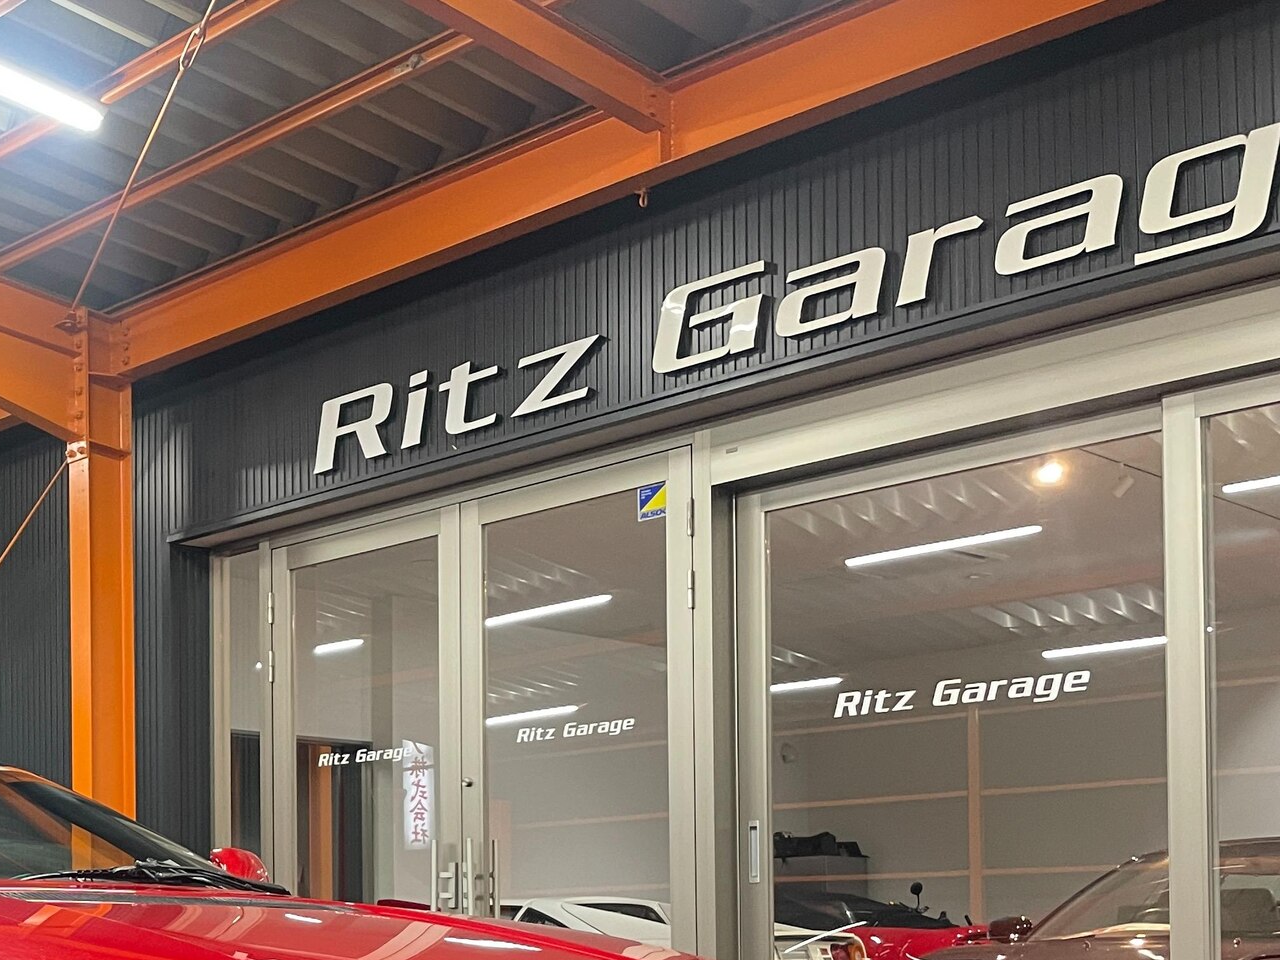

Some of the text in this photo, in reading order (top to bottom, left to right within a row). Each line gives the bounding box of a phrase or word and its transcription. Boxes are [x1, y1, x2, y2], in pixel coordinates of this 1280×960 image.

[313, 334, 600, 474] Ritz
[833, 670, 1091, 718] Ritz Garage
[516, 718, 635, 743] Ritz Garage
[317, 747, 412, 767] Ritz Garage
